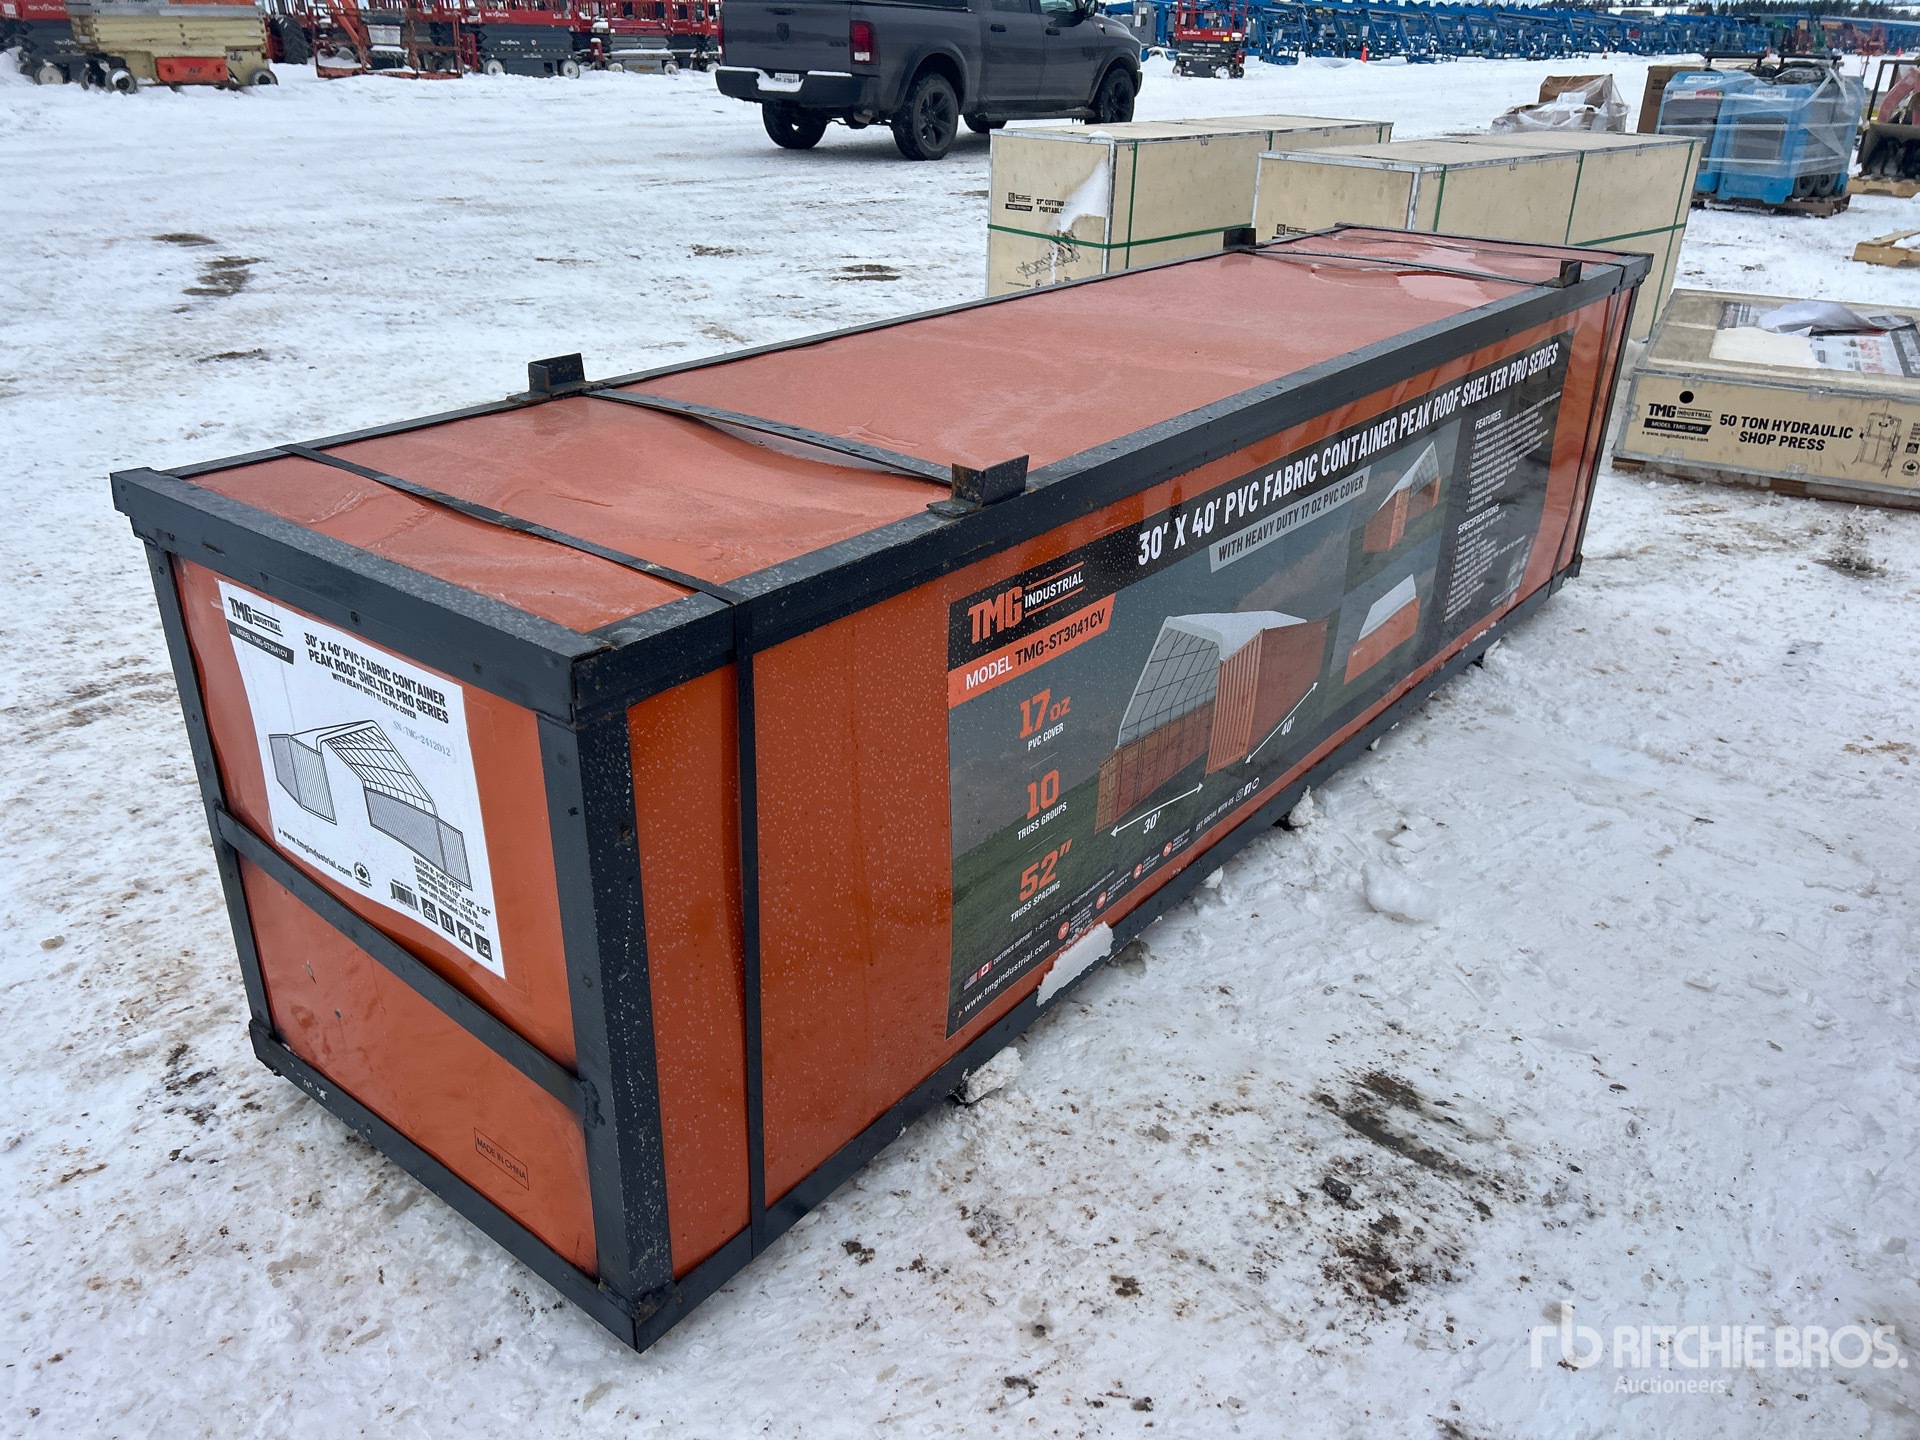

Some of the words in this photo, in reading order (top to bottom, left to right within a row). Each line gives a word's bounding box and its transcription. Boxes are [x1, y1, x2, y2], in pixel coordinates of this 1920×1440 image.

[1045, 199, 1065, 207] CUTTING
[1475, 409, 1502, 430] FEATURES
[1648, 403, 1677, 418] TMG
[1651, 421, 1671, 429] MODEL
[1672, 424, 1703, 432] TMG-SP50
[1677, 409, 1712, 419] INDUSTRIAL
[1719, 413, 1737, 427] 50
[1741, 416, 1770, 430] TON
[1771, 419, 1854, 440] HYDRAULIC
[1138, 521, 1169, 566] 30'
[1174, 513, 1187, 550] X
[1192, 497, 1221, 538] 40'
[1225, 481, 1260, 525] PVC
[1263, 453, 1318, 506] FABRIC
[1321, 417, 1397, 477] CONTAINER
[1399, 400, 1433, 440] PEAK
[1432, 386, 1461, 422] ROOF
[1461, 366, 1508, 408] SHELTER
[1508, 357, 1528, 387] PRO
[1528, 342, 1559, 376] SERIES
[1646, 431, 1709, 442] www.tmgindustrial.com
[1739, 431, 1777, 446] SHOP
[1778, 434, 1826, 451] PRESS
[1218, 536, 1243, 562] WITH
[1245, 521, 1275, 549] HEAVY
[1276, 507, 1299, 533] DUTY
[1301, 503, 1310, 520] 17
[1311, 496, 1322, 515] OZ
[1323, 490, 1339, 509] PVC
[1340, 475, 1364, 500] COVER
[1457, 503, 1500, 535] SPECIFICATIONS
[1024, 571, 1084, 609] INDUSTRIAL
[228, 596, 254, 624] TMG
[253, 613, 282, 632] INDUSTRIAL
[968, 586, 1023, 645] TMG
[235, 627, 252, 641] MODEL
[966, 656, 1013, 690] MODEL
[1015, 607, 1106, 666] TMG-ST3041CV
[304, 632, 317, 648] 30'
[327, 641, 341, 657] 40'
[343, 647, 360, 666] PVC
[360, 655, 391, 682] FABRIC
[392, 671, 446, 707] CONTAINER
[308, 648, 334, 669] PEAK
[334, 658, 357, 678] ROOF
[358, 669, 396, 699] SHELTER
[395, 688, 414, 708] PRO
[415, 698, 449, 724] SERIES
[331, 672, 346, 684] WITH
[346, 677, 362, 691] HEAVY
[363, 686, 376, 698] DUTY
[389, 701, 399, 711] PVC
[399, 705, 417, 720] COVER
[1019, 688, 1051, 739] 17
[1027, 735, 1042, 751] PVC
[1043, 722, 1064, 744] COVER
[1281, 716, 1296, 736] 40'
[1026, 769, 1060, 821] 10
[1017, 819, 1040, 841] TRUSS
[1041, 801, 1067, 826] GROUPS
[1143, 810, 1161, 834] 30'
[282, 829, 353, 878] www.tmgindustrial.com
[1019, 838, 1073, 902] 52"
[418, 883, 428, 895] One
[428, 891, 438, 902] unit
[438, 896, 459, 915] included
[464, 914, 475, 926] this
[475, 920, 486, 933] box
[1010, 901, 1032, 922] TRUSS
[1032, 880, 1061, 906] SPACING
[993, 944, 1015, 965] CUSTOMER
[1014, 930, 1034, 950] SUPPORT
[964, 939, 1050, 1013] www.tmgindustrial.com
[476, 1137, 496, 1158] MADE
[496, 1152, 504, 1164] IN
[504, 1159, 527, 1180] CHINA
